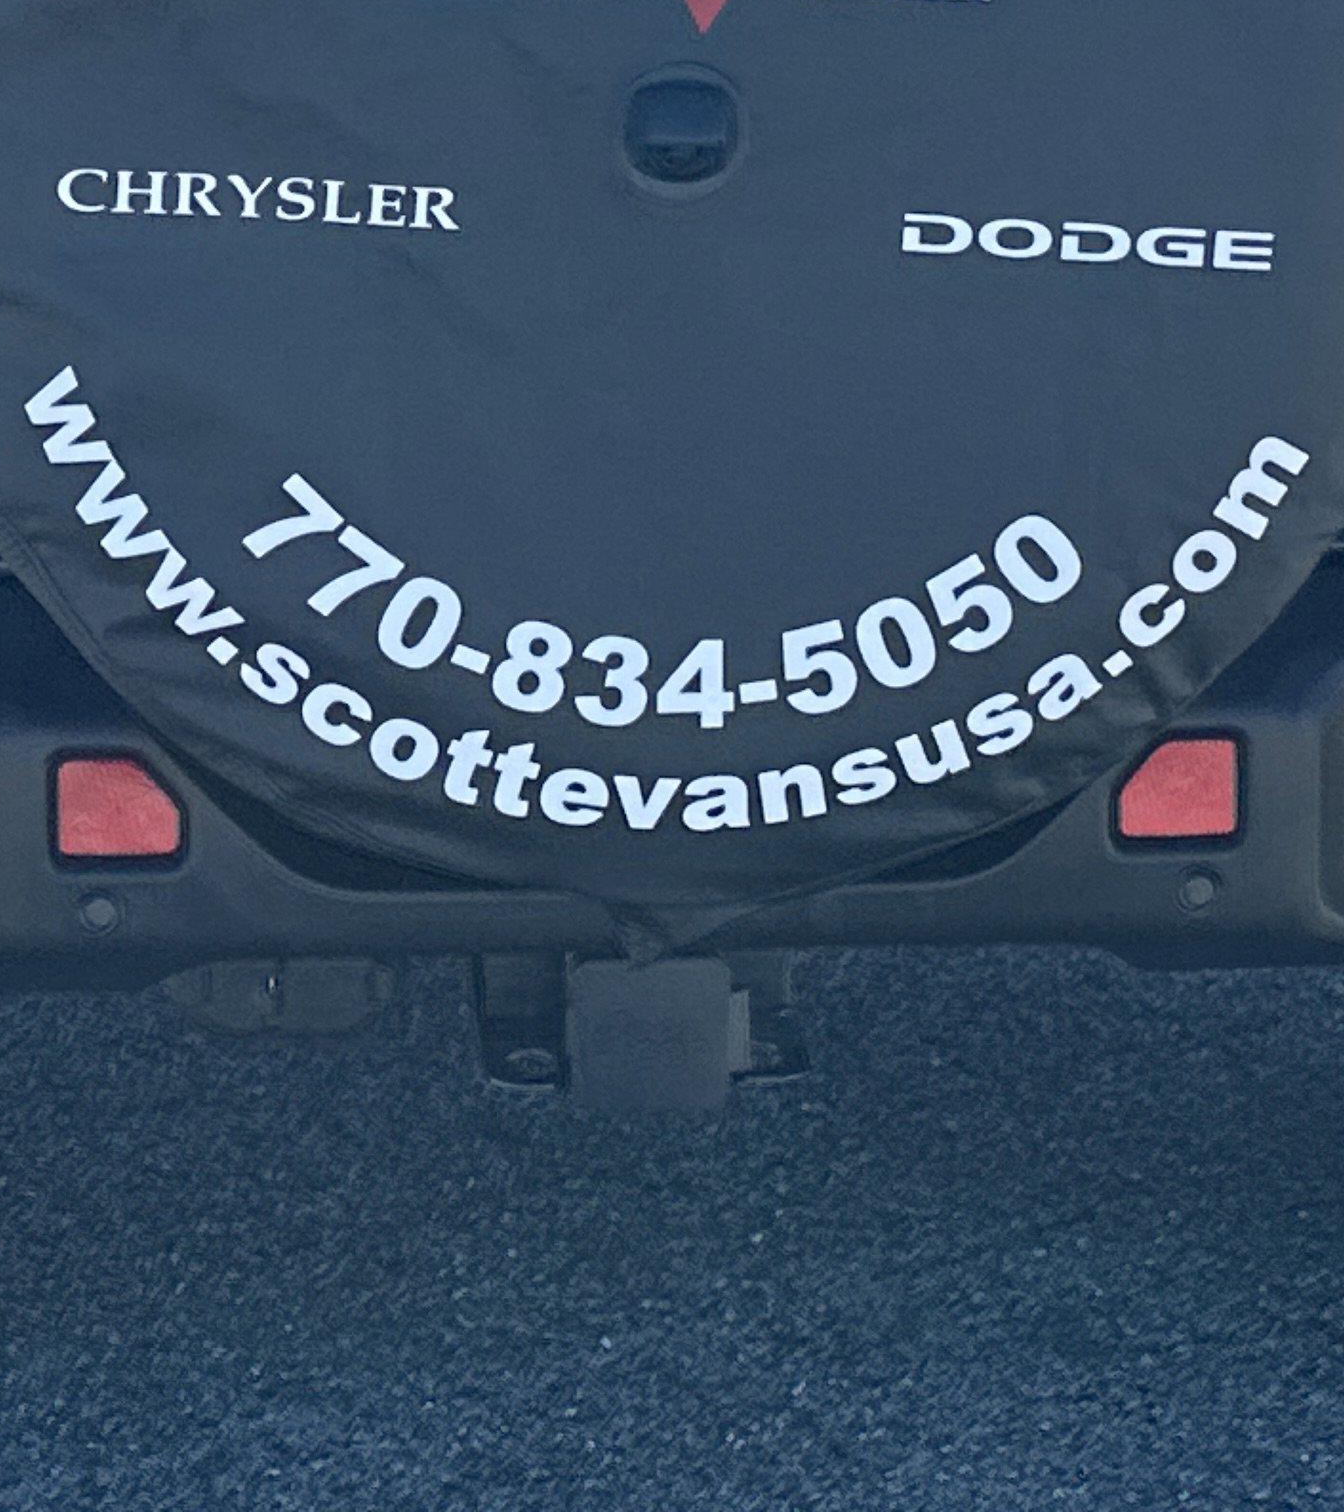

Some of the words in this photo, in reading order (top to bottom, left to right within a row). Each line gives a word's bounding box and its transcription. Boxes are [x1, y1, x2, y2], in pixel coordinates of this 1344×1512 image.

[57, 168, 460, 231] CHRYSLER
[902, 213, 1275, 271] DODGE
[23, 366, 1310, 832] www.scottevansusa.com
[242, 475, 1084, 729] 770-834-5050
